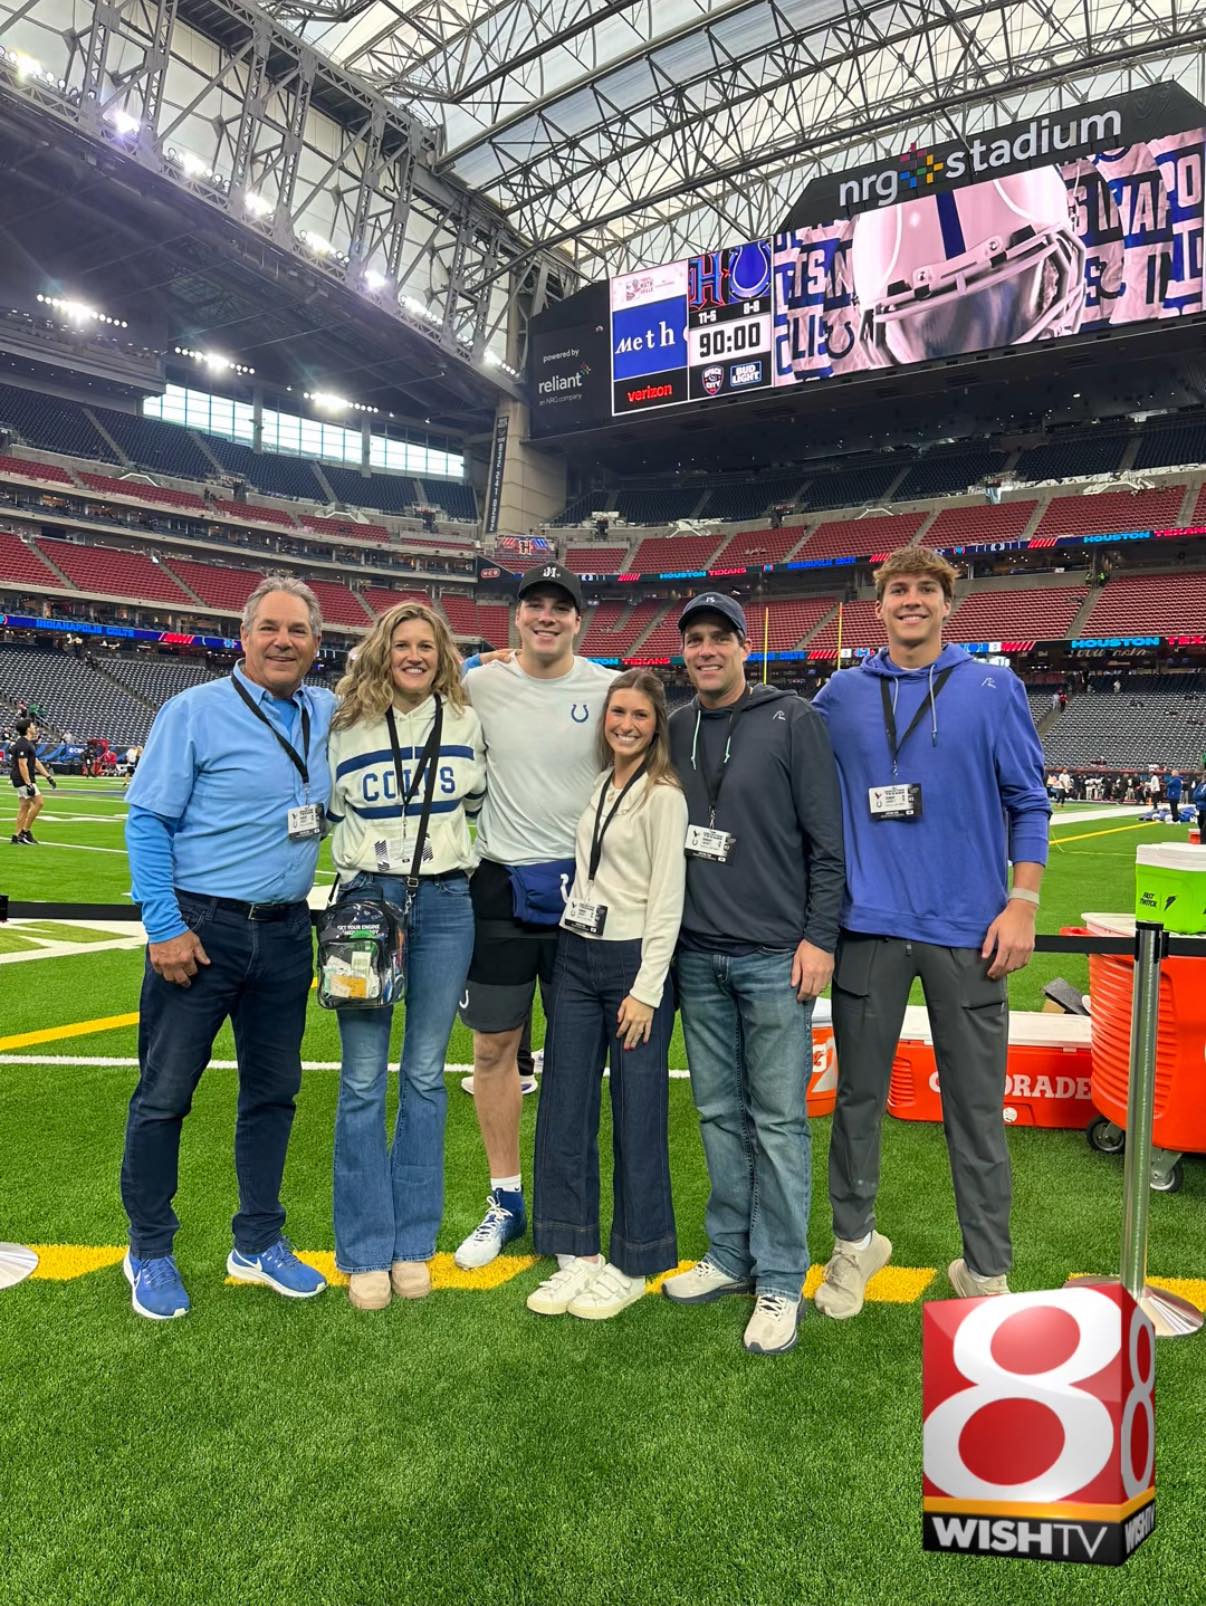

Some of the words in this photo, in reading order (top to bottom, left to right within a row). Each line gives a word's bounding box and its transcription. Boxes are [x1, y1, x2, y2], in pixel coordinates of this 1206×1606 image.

[839, 170, 899, 207] nrg
[945, 110, 1121, 178] stadium
[699, 321, 761, 358] 90:00
[543, 349, 571, 363] powered
[571, 348, 580, 357] by
[736, 364, 757, 375] BUD
[538, 372, 583, 394] reliant
[731, 371, 760, 384] LIGHT
[627, 383, 673, 402] verizon
[1082, 531, 1151, 544] HOUSTON
[660, 570, 707, 580] HOUSTON
[708, 566, 747, 576] TEXANS
[1071, 636, 1160, 649] HOUSTON
[622, 656, 671, 666] TEXANS
